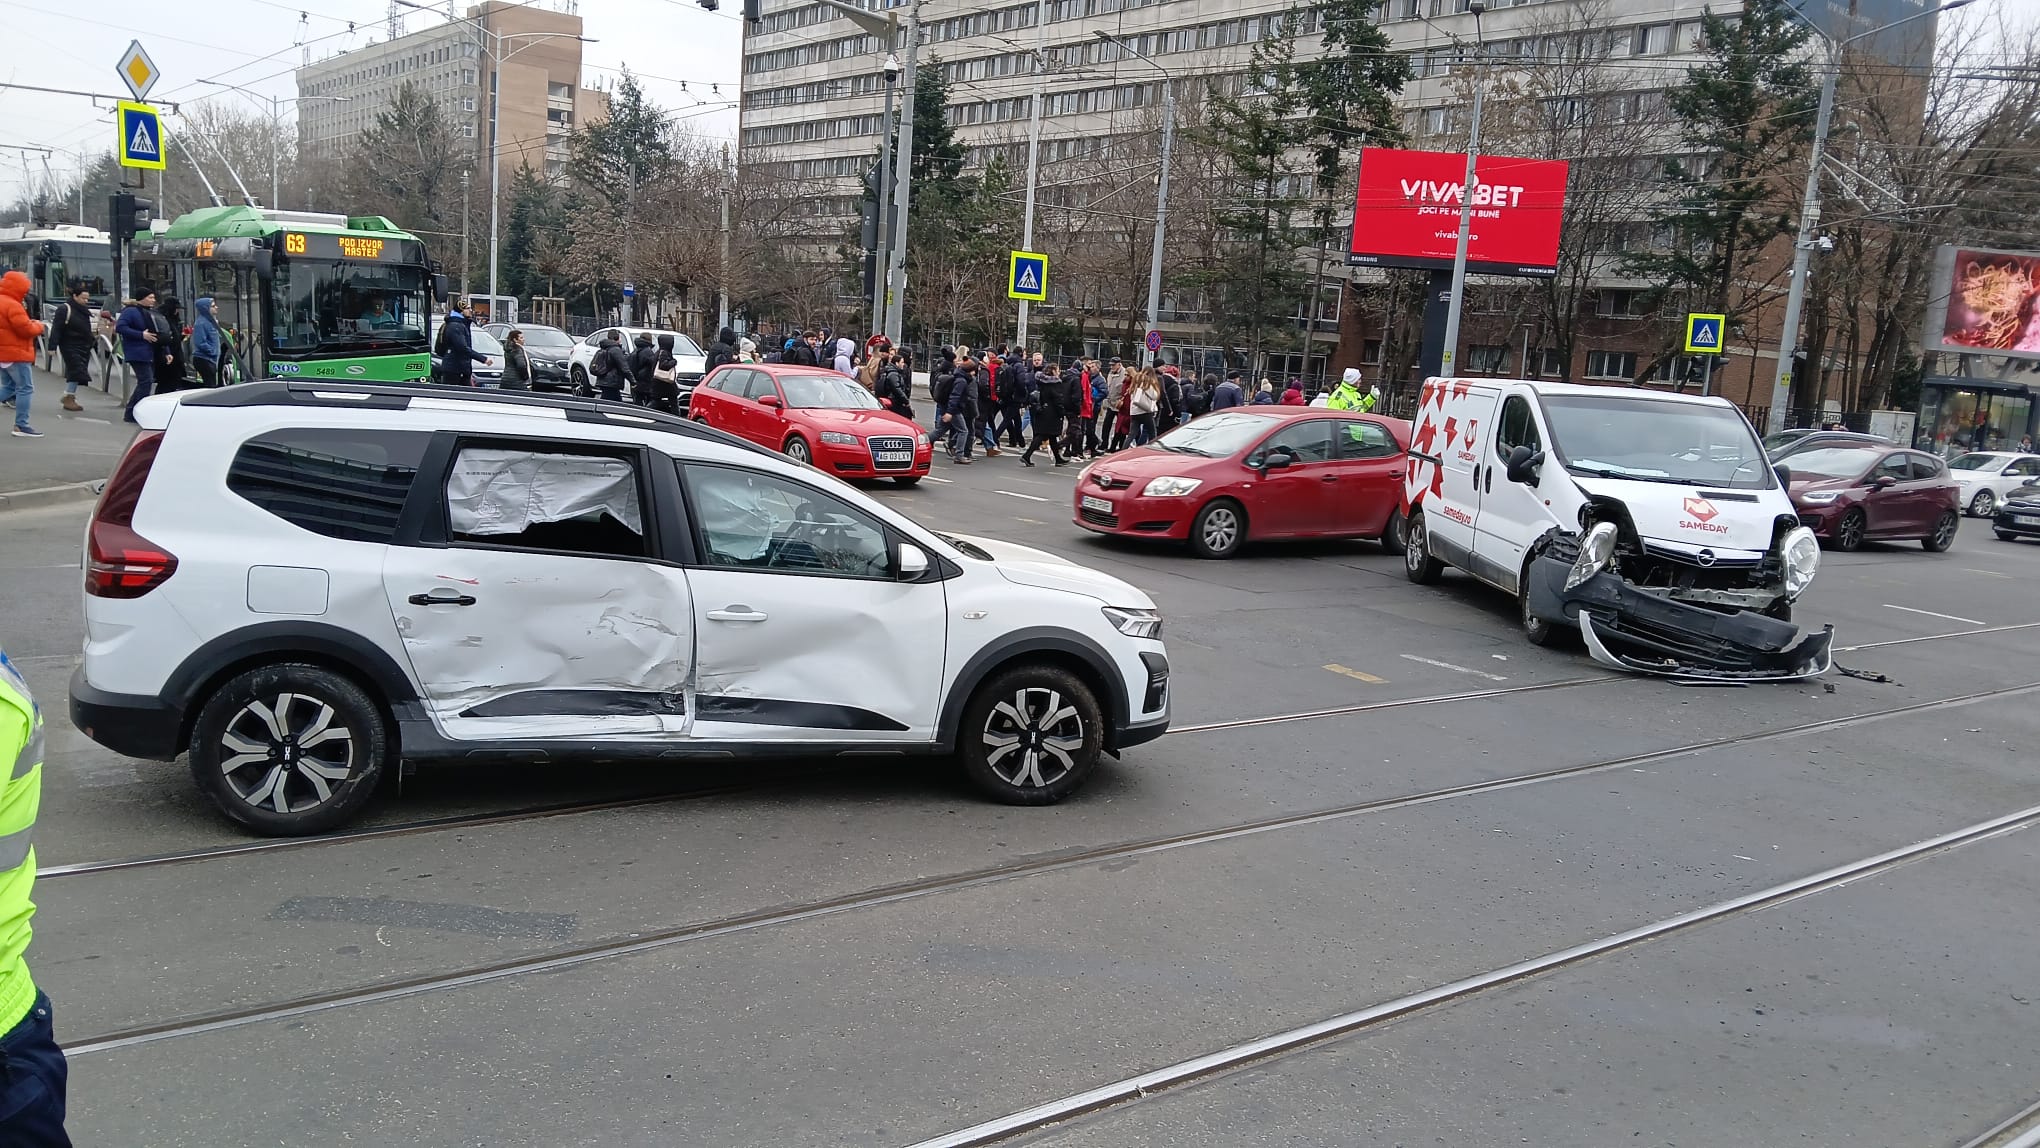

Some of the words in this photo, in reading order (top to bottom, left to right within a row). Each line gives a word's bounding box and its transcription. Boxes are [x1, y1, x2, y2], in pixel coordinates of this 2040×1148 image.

[1417, 206, 1437, 215] JOCI
[1439, 207, 1450, 215] PE
[1478, 210, 1500, 218] BUNE
[286, 233, 305, 253] 63
[339, 238, 355, 247] POD
[358, 239, 383, 249] IZVOR
[344, 247, 378, 257] MASTER
[316, 367, 335, 375] 5489
[1457, 450, 1476, 462] SAMEDAY
[1443, 506, 1472, 524] sameday.ro
[1679, 520, 1728, 534] SAMEDAY
